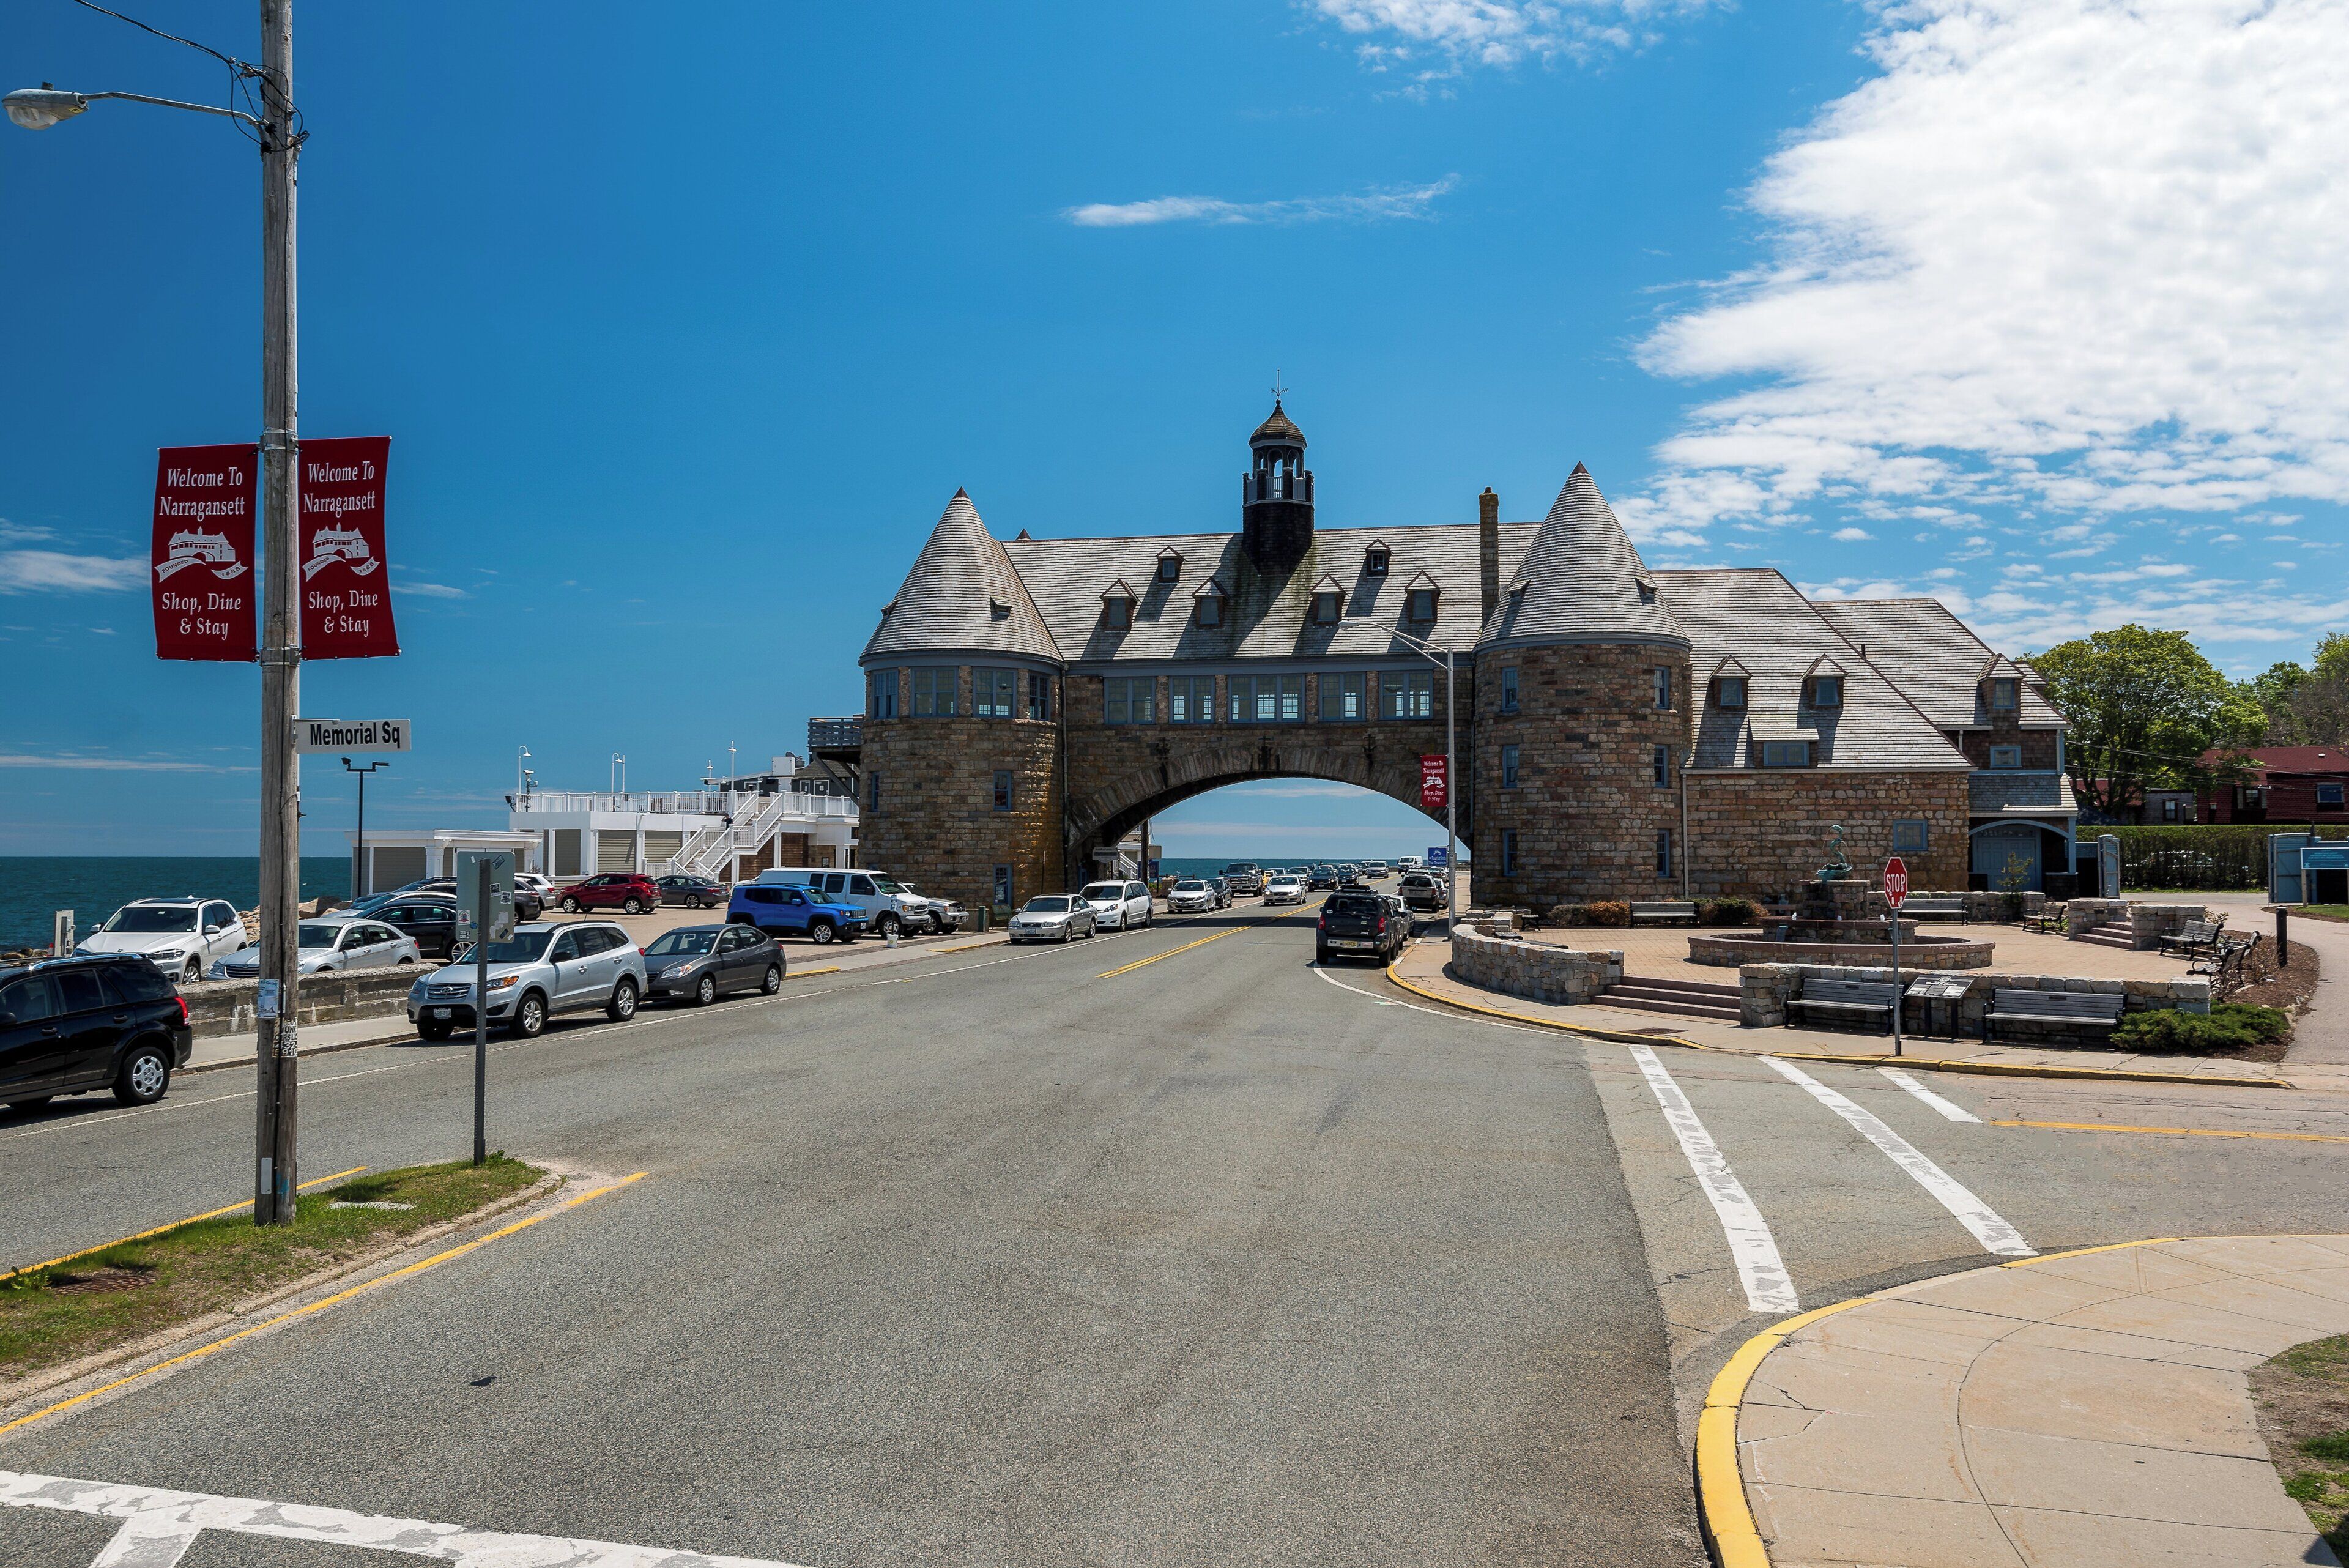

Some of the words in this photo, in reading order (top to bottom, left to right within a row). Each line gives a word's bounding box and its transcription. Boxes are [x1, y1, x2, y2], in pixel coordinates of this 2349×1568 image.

[167, 467, 224, 488] Welcome
[228, 466, 243, 486] To
[308, 462, 358, 483] Welcome
[362, 460, 374, 480] To
[159, 496, 245, 522] Narragansett
[303, 491, 376, 518] Narragansett
[161, 559, 188, 573] FOUNDED
[221, 566, 240, 577] 1888
[308, 557, 330, 572] FOUNDED
[359, 562, 374, 573] 1888
[162, 592, 202, 615] Shop,
[207, 593, 242, 611] Dine
[308, 591, 344, 614] Shop,
[349, 590, 379, 607] Dine
[179, 617, 191, 634] &
[196, 617, 229, 641] Stay
[324, 616, 335, 633] &
[340, 615, 369, 637] Stay
[310, 721, 377, 746] Memorial
[382, 721, 401, 749] Sq
[1886, 874, 1906, 893] STOP
